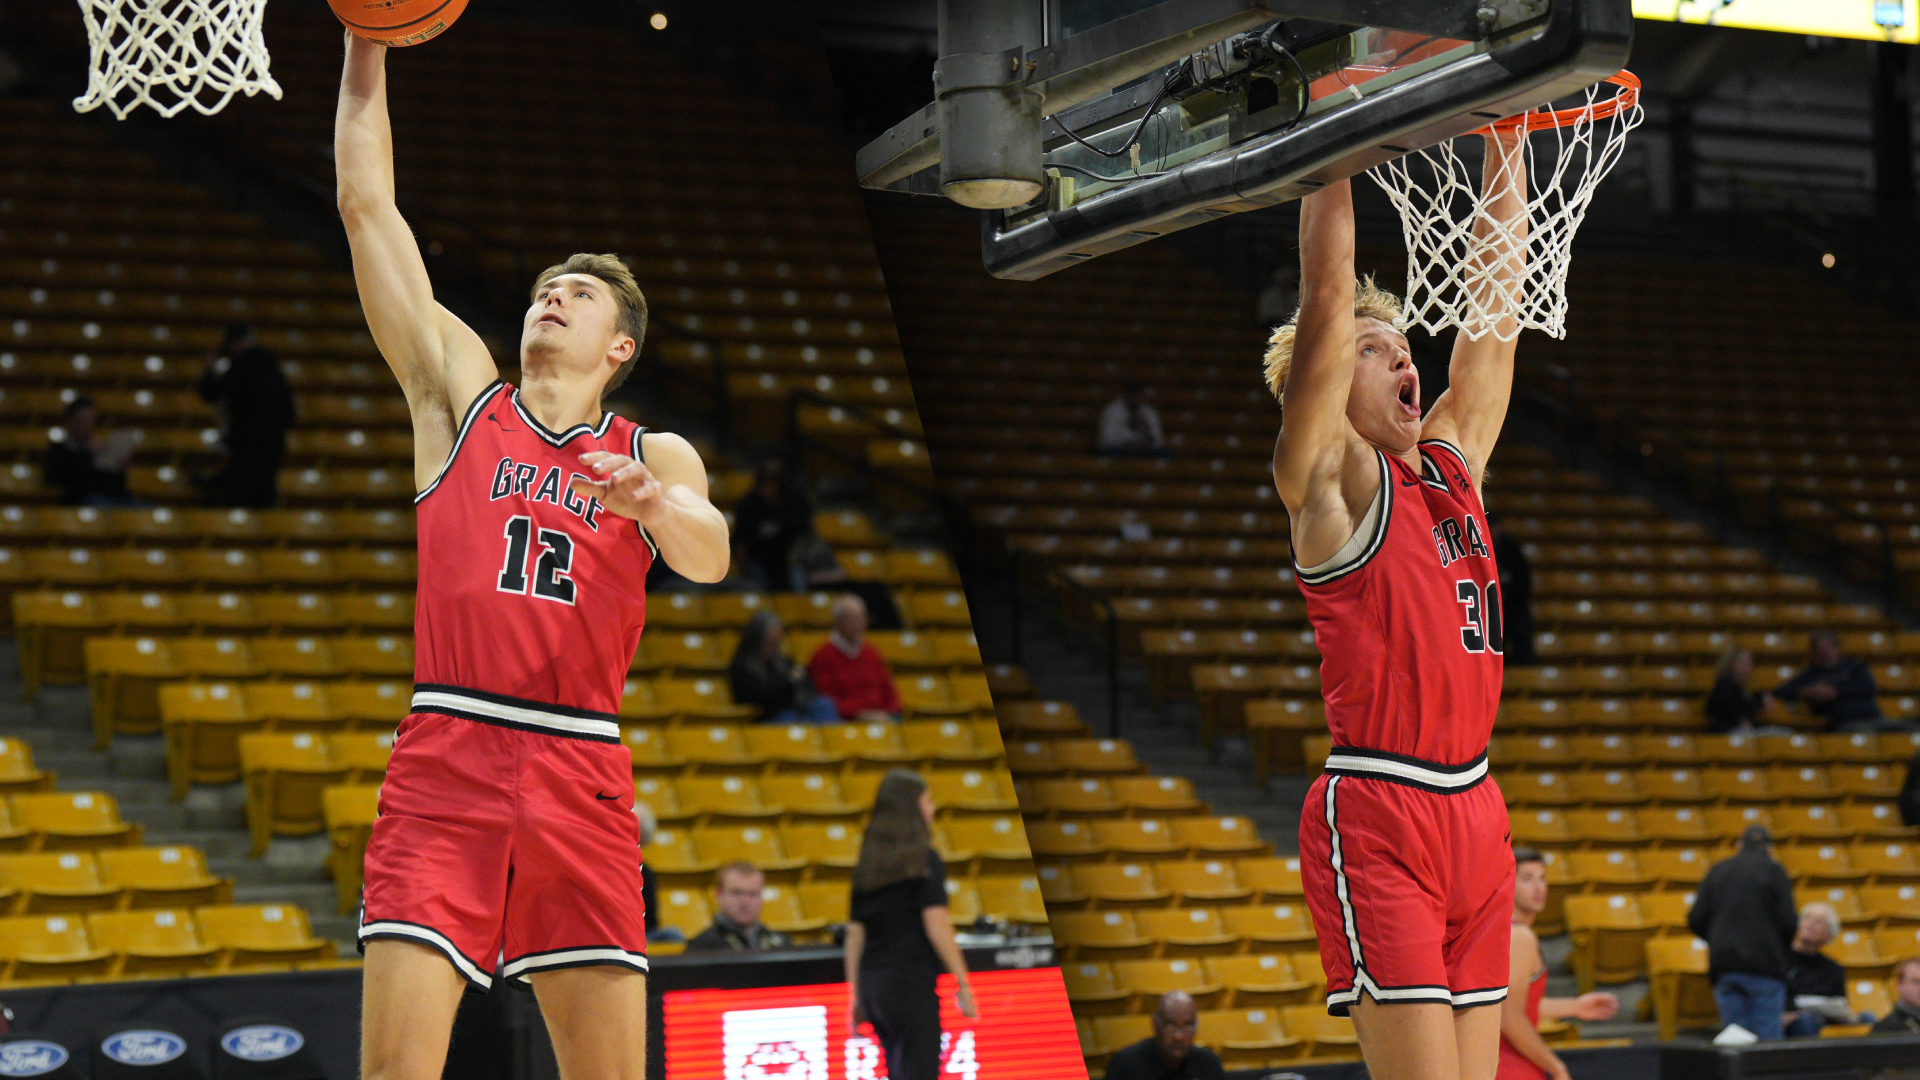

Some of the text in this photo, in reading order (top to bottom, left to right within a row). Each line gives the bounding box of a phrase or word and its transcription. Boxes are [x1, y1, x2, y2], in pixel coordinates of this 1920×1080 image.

[1432, 514, 1491, 568] GRA
[496, 515, 577, 606] 12
[116, 1033, 172, 1061] Ford
[234, 1029, 289, 1057] Ford
[0, 1044, 53, 1073] Ford
